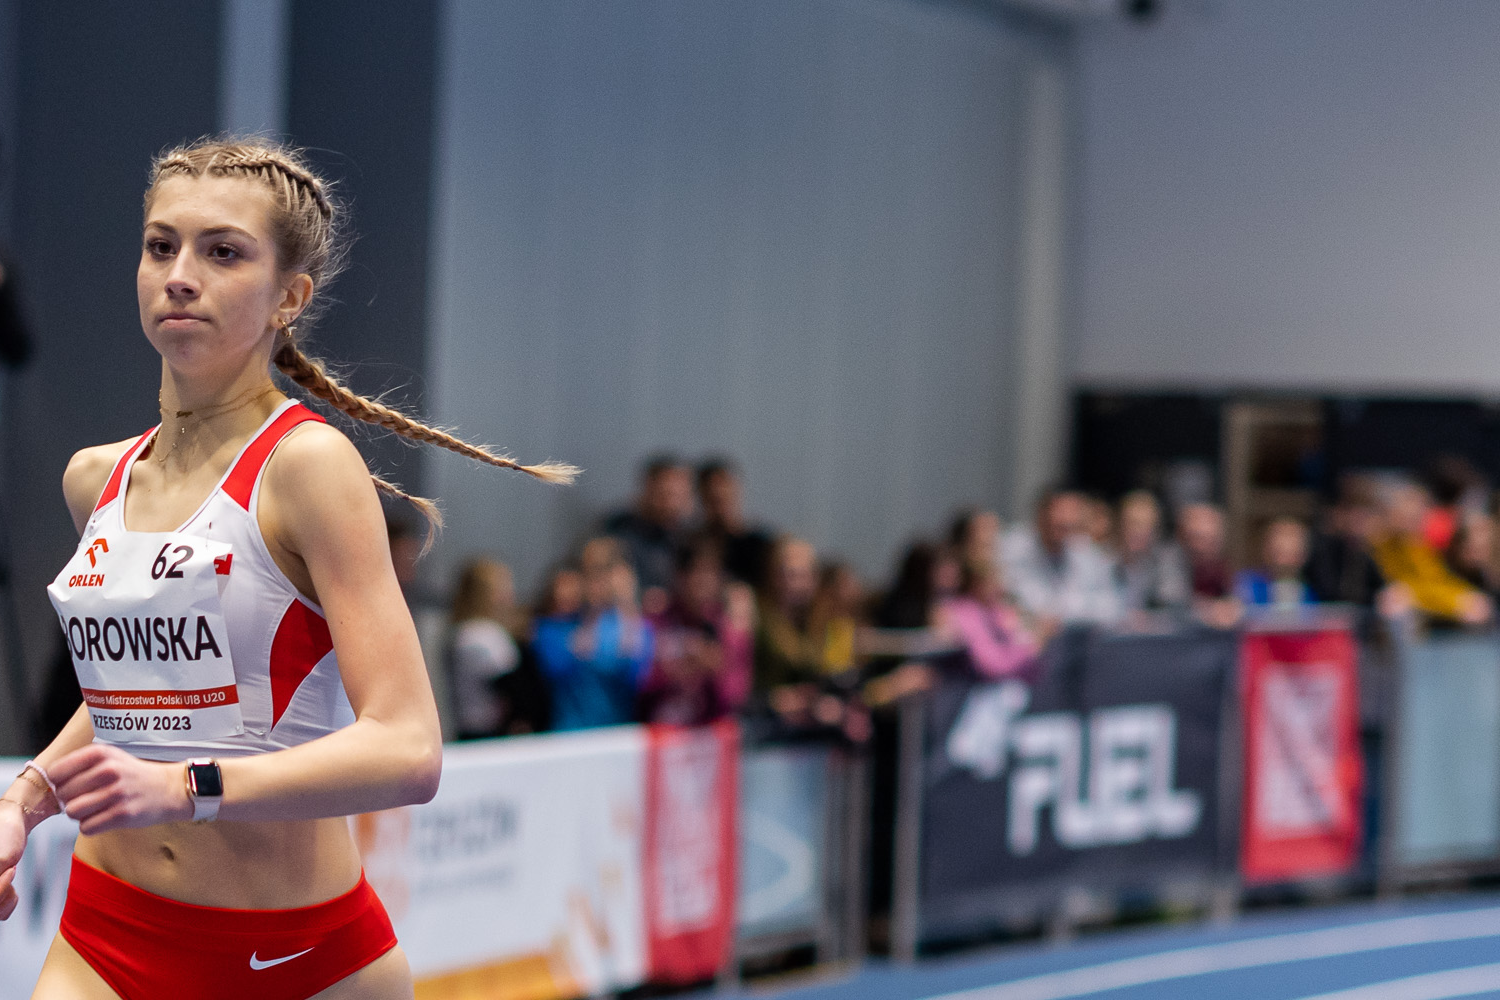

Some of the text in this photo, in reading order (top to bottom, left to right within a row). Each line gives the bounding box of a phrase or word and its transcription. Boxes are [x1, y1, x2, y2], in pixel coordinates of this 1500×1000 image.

[151, 542, 194, 580] 62
[68, 573, 105, 588] ORLEN
[106, 695, 155, 705] Mistrzostwa
[157, 694, 183, 705] Polski
[184, 694, 200, 705] U18
[203, 691, 226, 703] U20
[153, 715, 192, 731] 2023
[1006, 704, 1198, 858] FUEL
